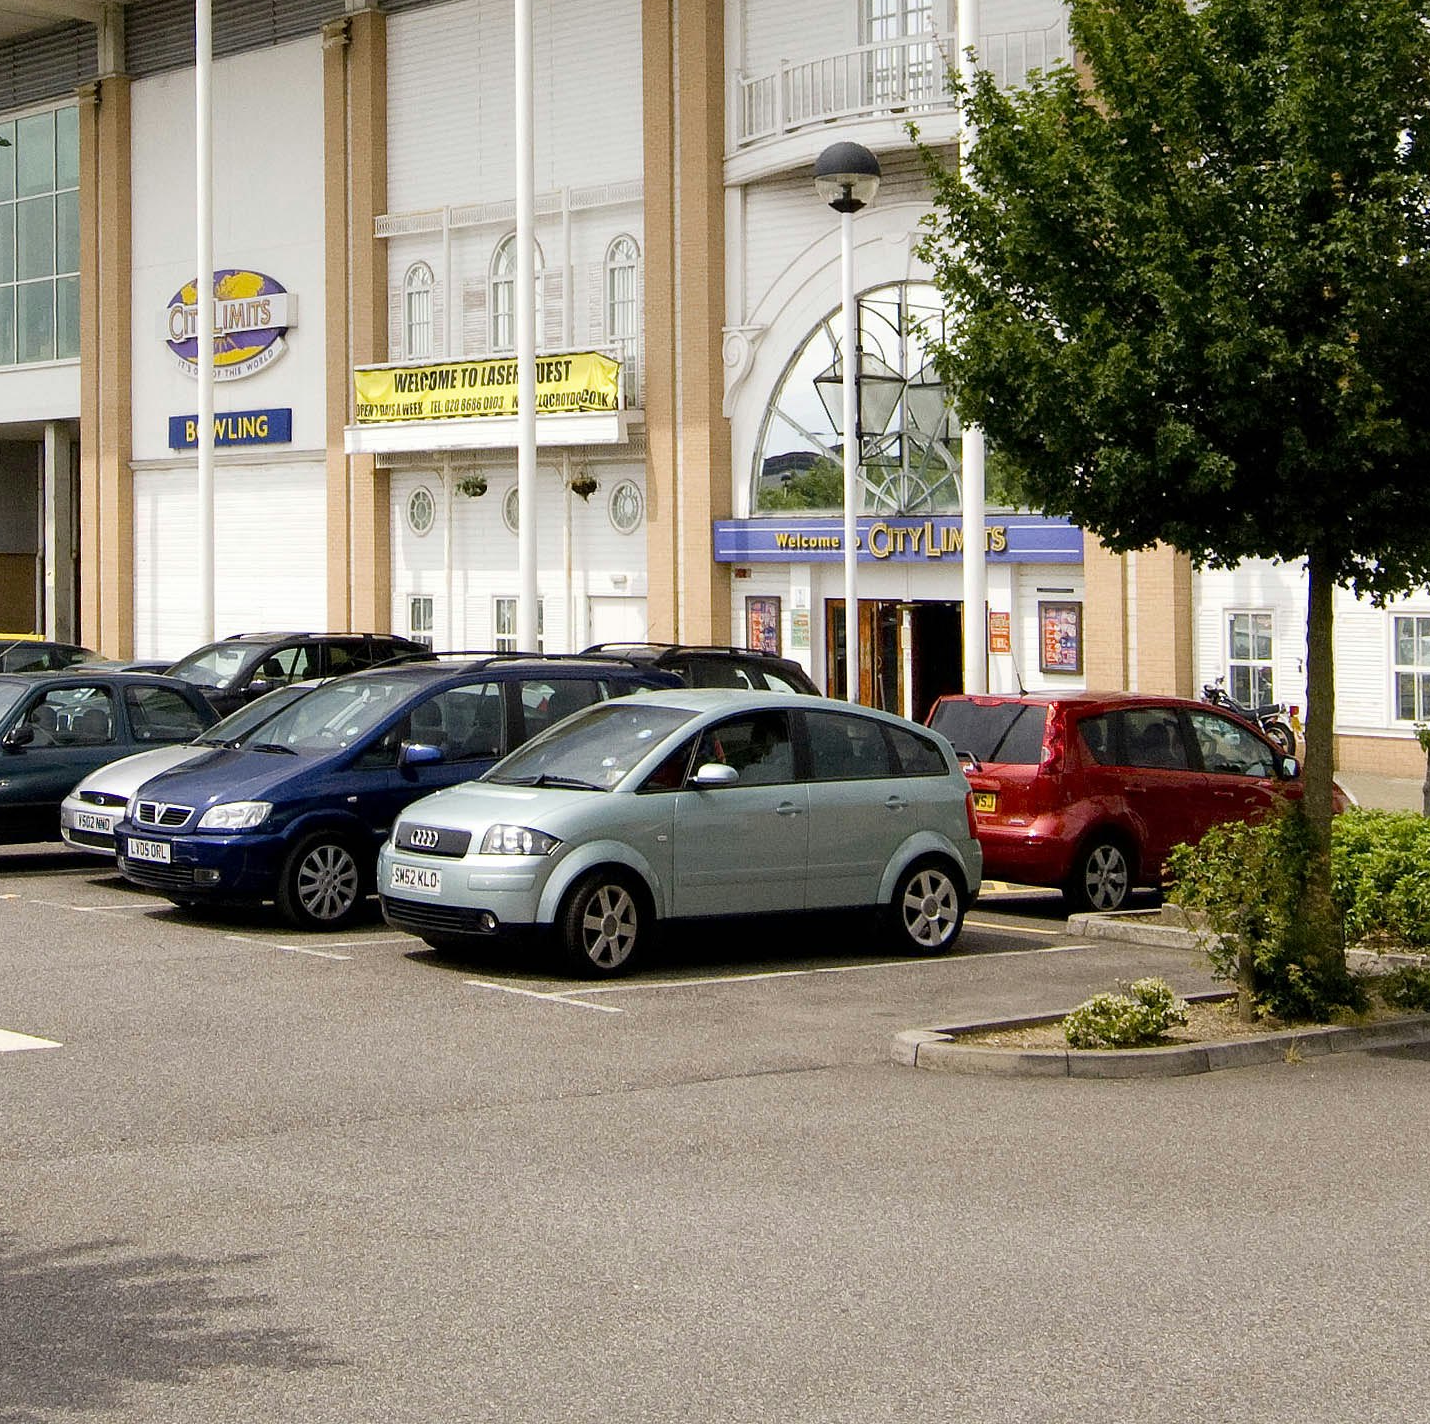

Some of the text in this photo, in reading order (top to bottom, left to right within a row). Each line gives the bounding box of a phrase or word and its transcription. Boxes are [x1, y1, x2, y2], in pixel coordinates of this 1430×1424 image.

[169, 299, 272, 341] CITLIMITS
[225, 366, 242, 377] THIS
[246, 350, 274, 371] WORLD
[394, 369, 459, 393] WELCOME
[461, 367, 478, 389] TO
[535, 360, 572, 384] UEST
[402, 401, 423, 416] WEEK
[445, 398, 460, 413] 020
[461, 397, 482, 412] 8686
[185, 415, 269, 443] BWLING
[774, 532, 841, 550] Welcome
[868, 521, 1008, 559] CITYLIMTS
[417, 870, 438, 888] KLO
